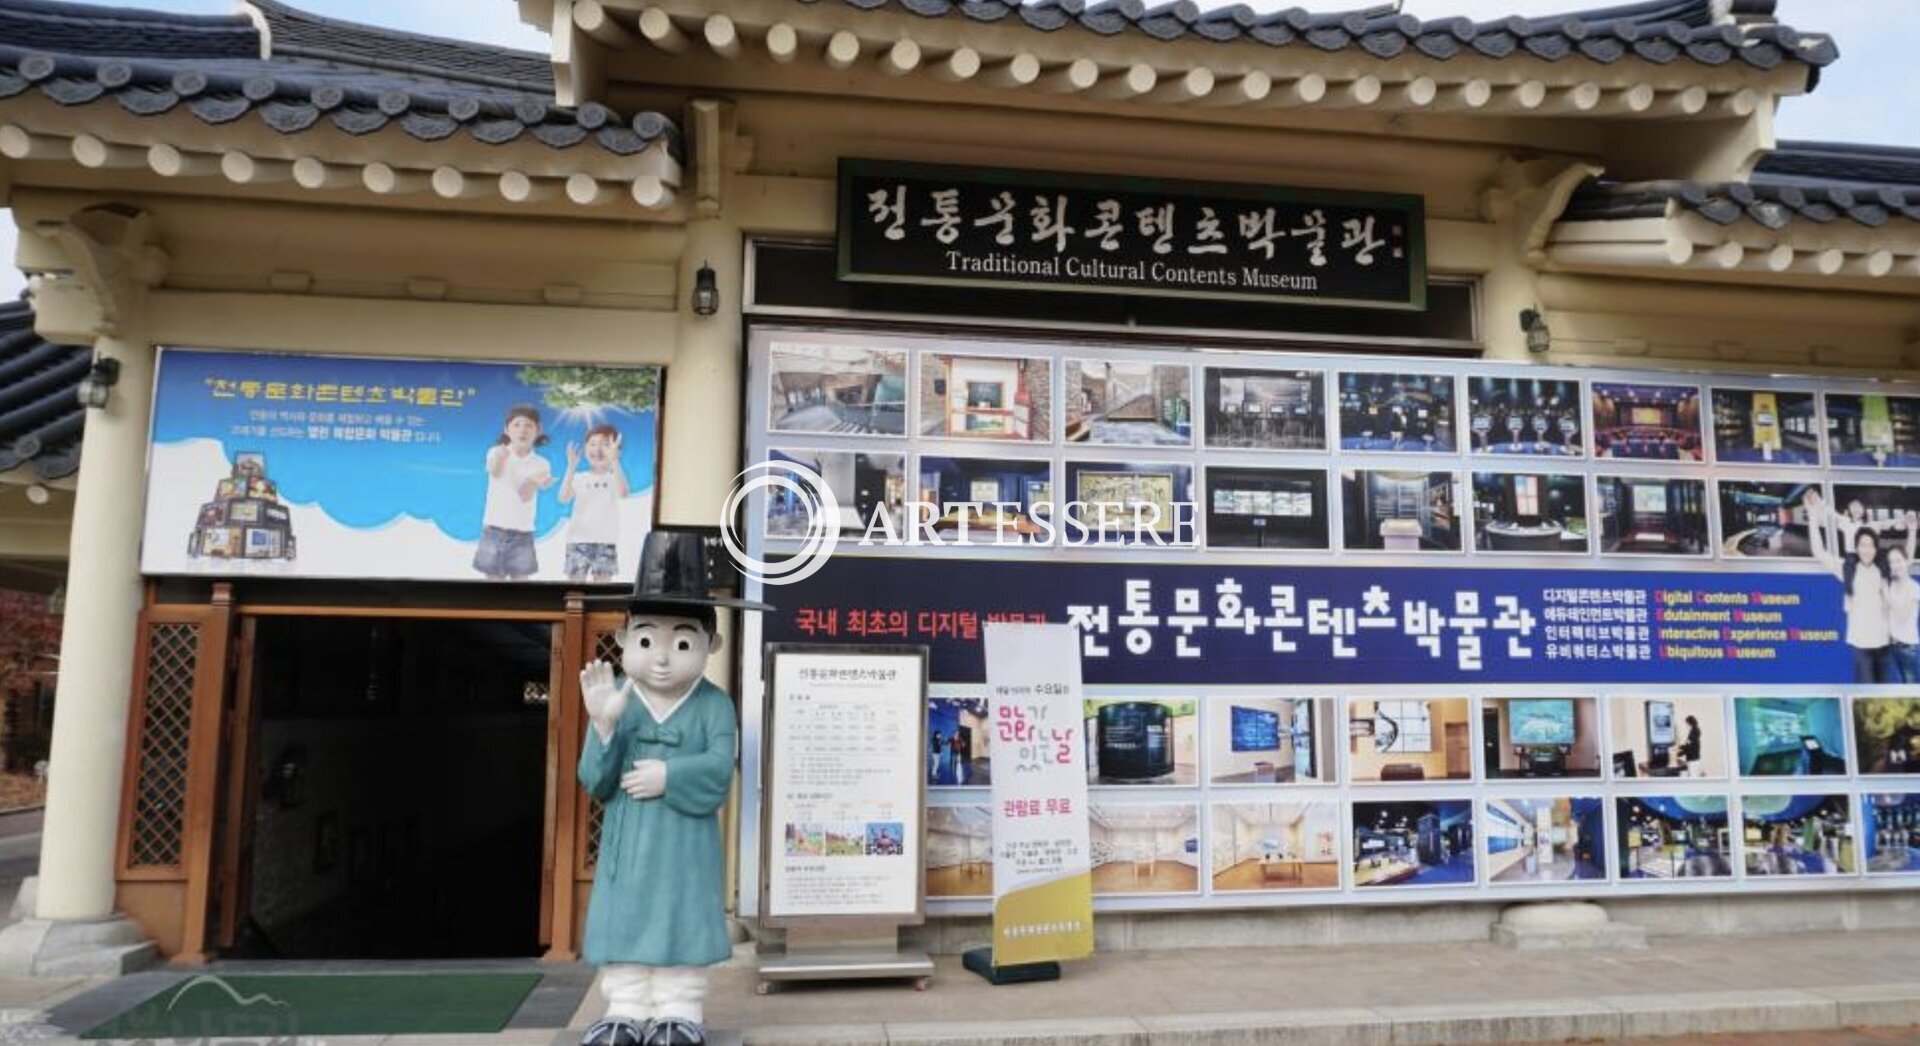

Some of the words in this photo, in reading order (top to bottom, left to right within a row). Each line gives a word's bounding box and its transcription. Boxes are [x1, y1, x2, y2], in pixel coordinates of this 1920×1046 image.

[867, 185, 1387, 267] 전통문화콘텐츠박물관
[945, 250, 1059, 275] Traditional
[1065, 256, 1145, 281] Cultural
[1151, 262, 1237, 286] Contents
[1242, 266, 1318, 291] Museum
[1655, 590, 1693, 606] Digital
[1696, 592, 1749, 604] Contents
[1751, 592, 1800, 605] Museum
[796, 608, 838, 636] 국내
[846, 609, 908, 637] 최초의
[918, 611, 978, 639] 디지털
[1067, 578, 1537, 670] 전통문화콘텐츠박물관
[1656, 609, 1730, 622] Edutainment
[1733, 610, 1782, 623] Museum
[1658, 627, 1720, 641] Interactive
[1722, 627, 1786, 643] Experience
[1788, 628, 1839, 641] Museum
[1659, 645, 1724, 661] Ubiquitous
[1726, 647, 1776, 659] Museum
[1004, 800, 1040, 817] 관람료
[1045, 799, 1072, 815] 무료
